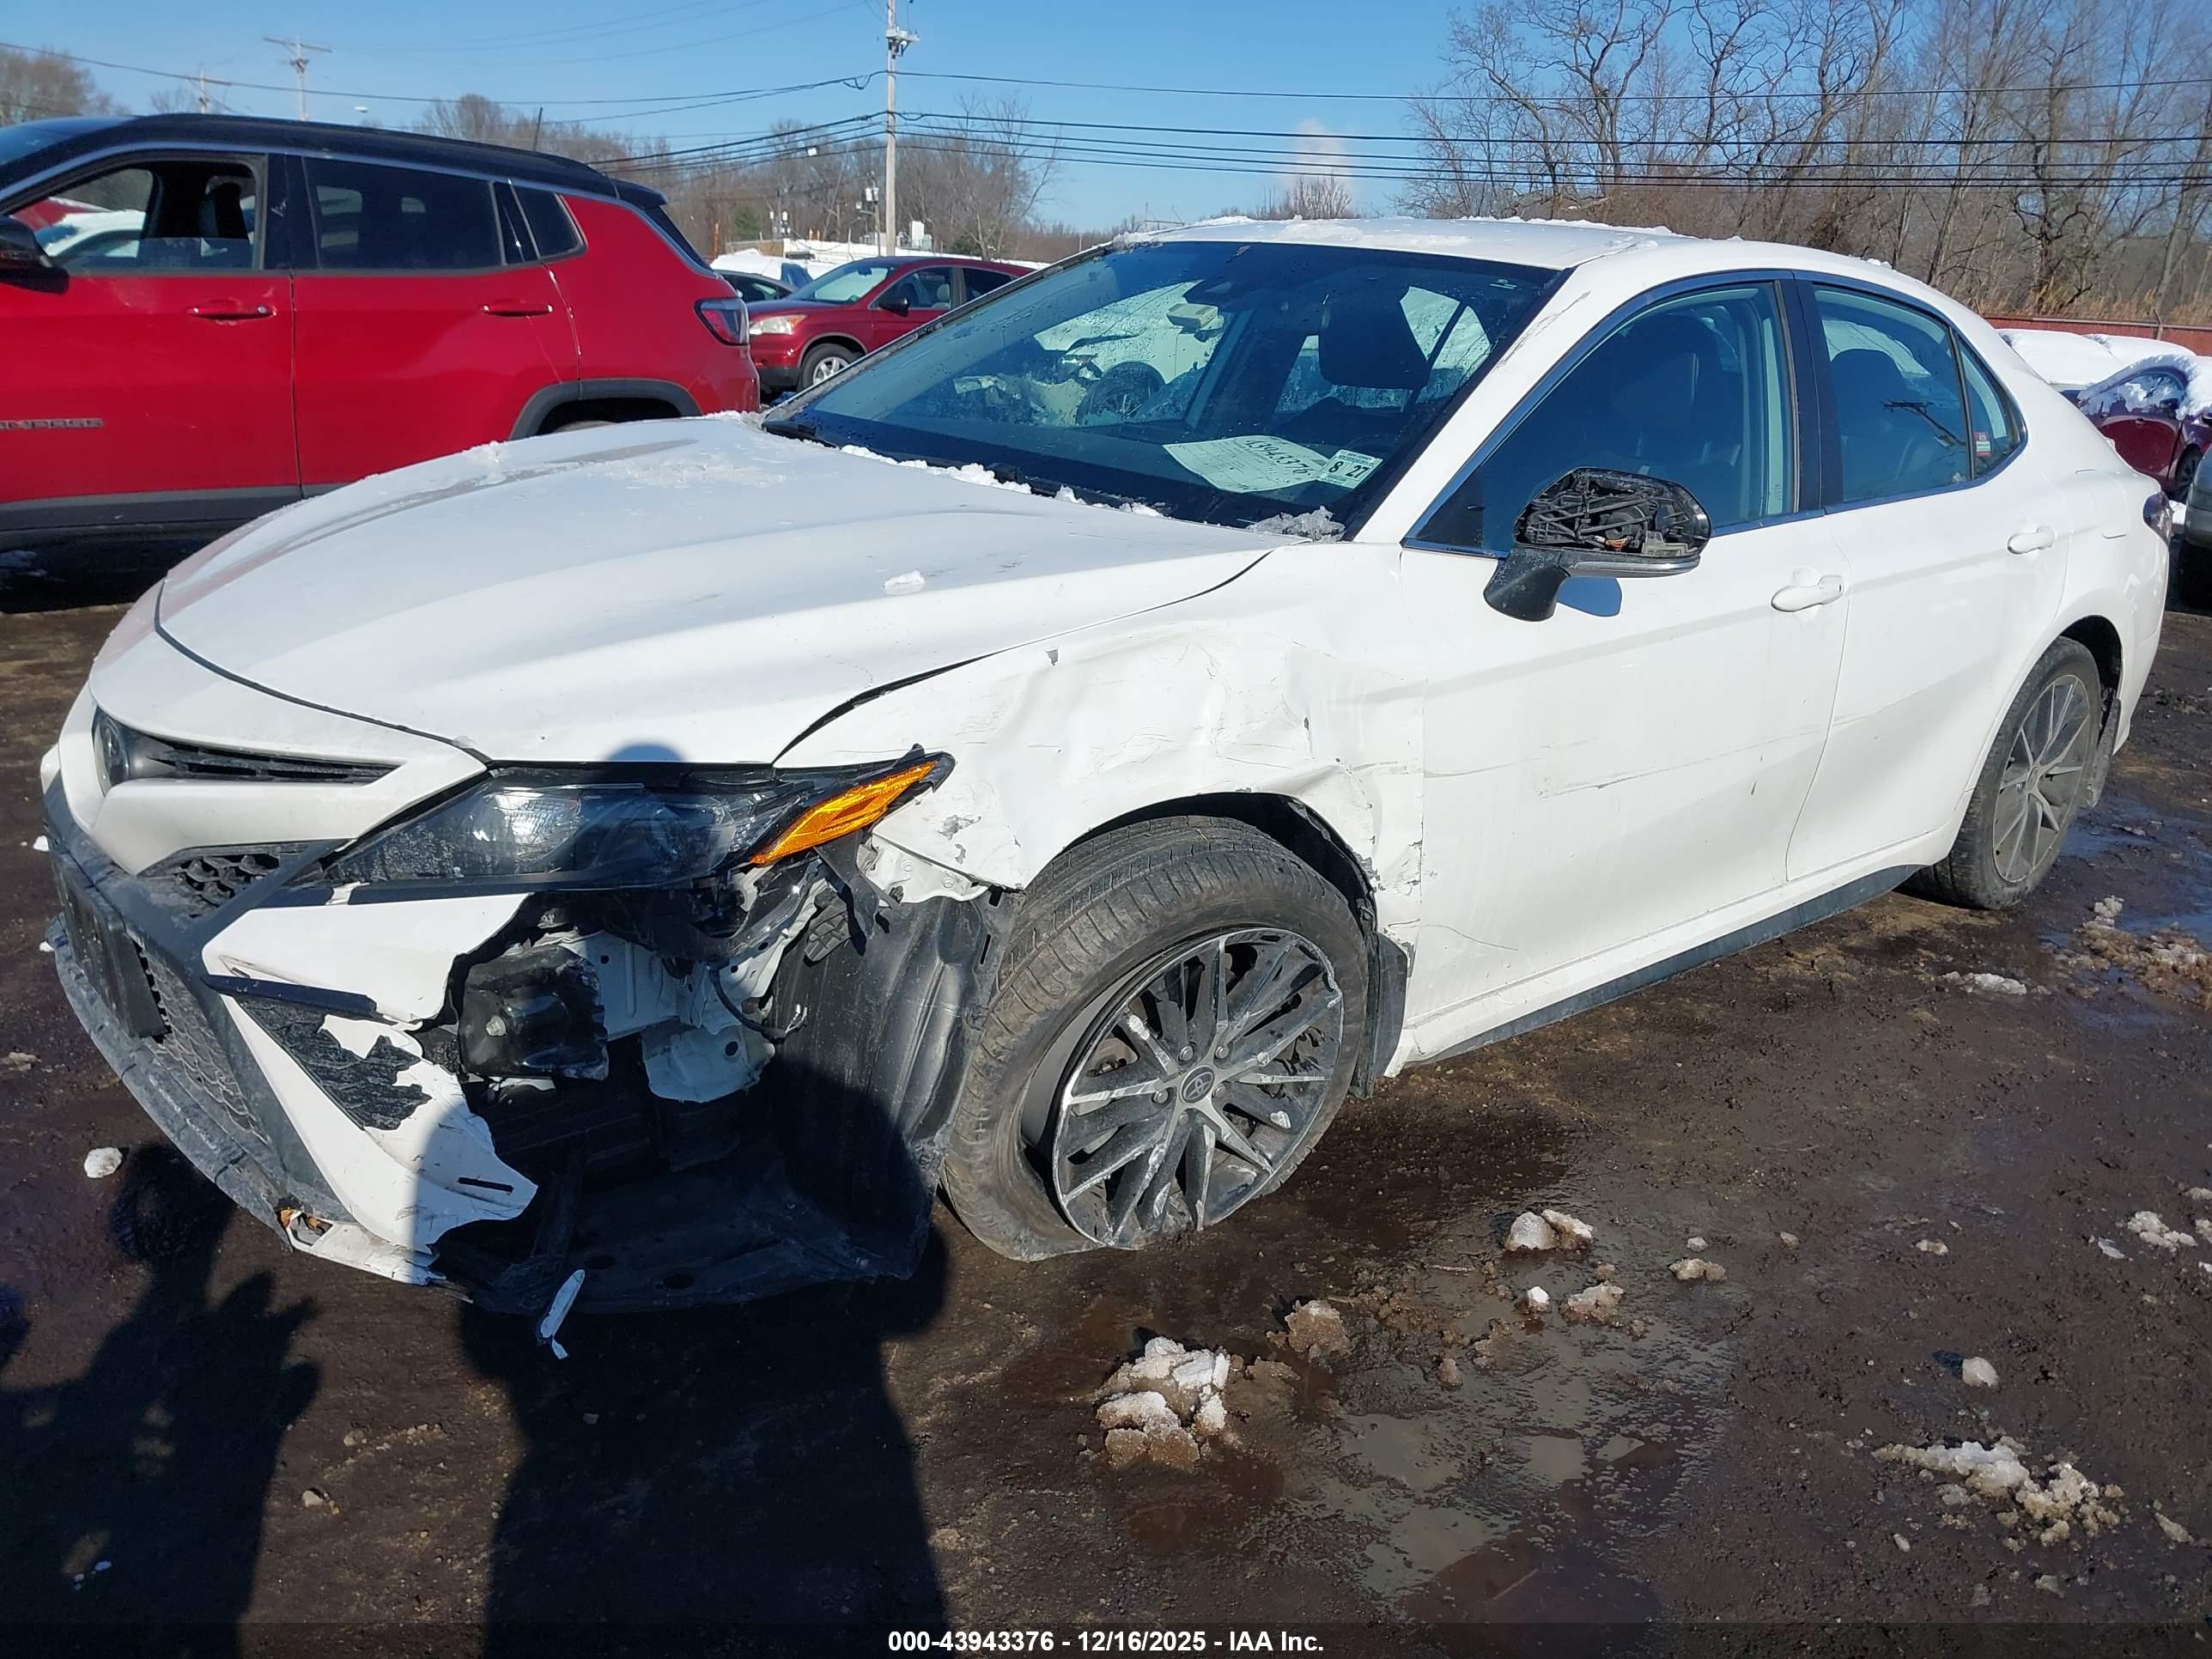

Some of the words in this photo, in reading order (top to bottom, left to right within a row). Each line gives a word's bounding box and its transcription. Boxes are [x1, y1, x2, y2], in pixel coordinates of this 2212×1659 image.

[1245, 440, 1315, 475] 43943376
[1328, 461, 1344, 472] 8
[1346, 465, 1370, 478] 27
